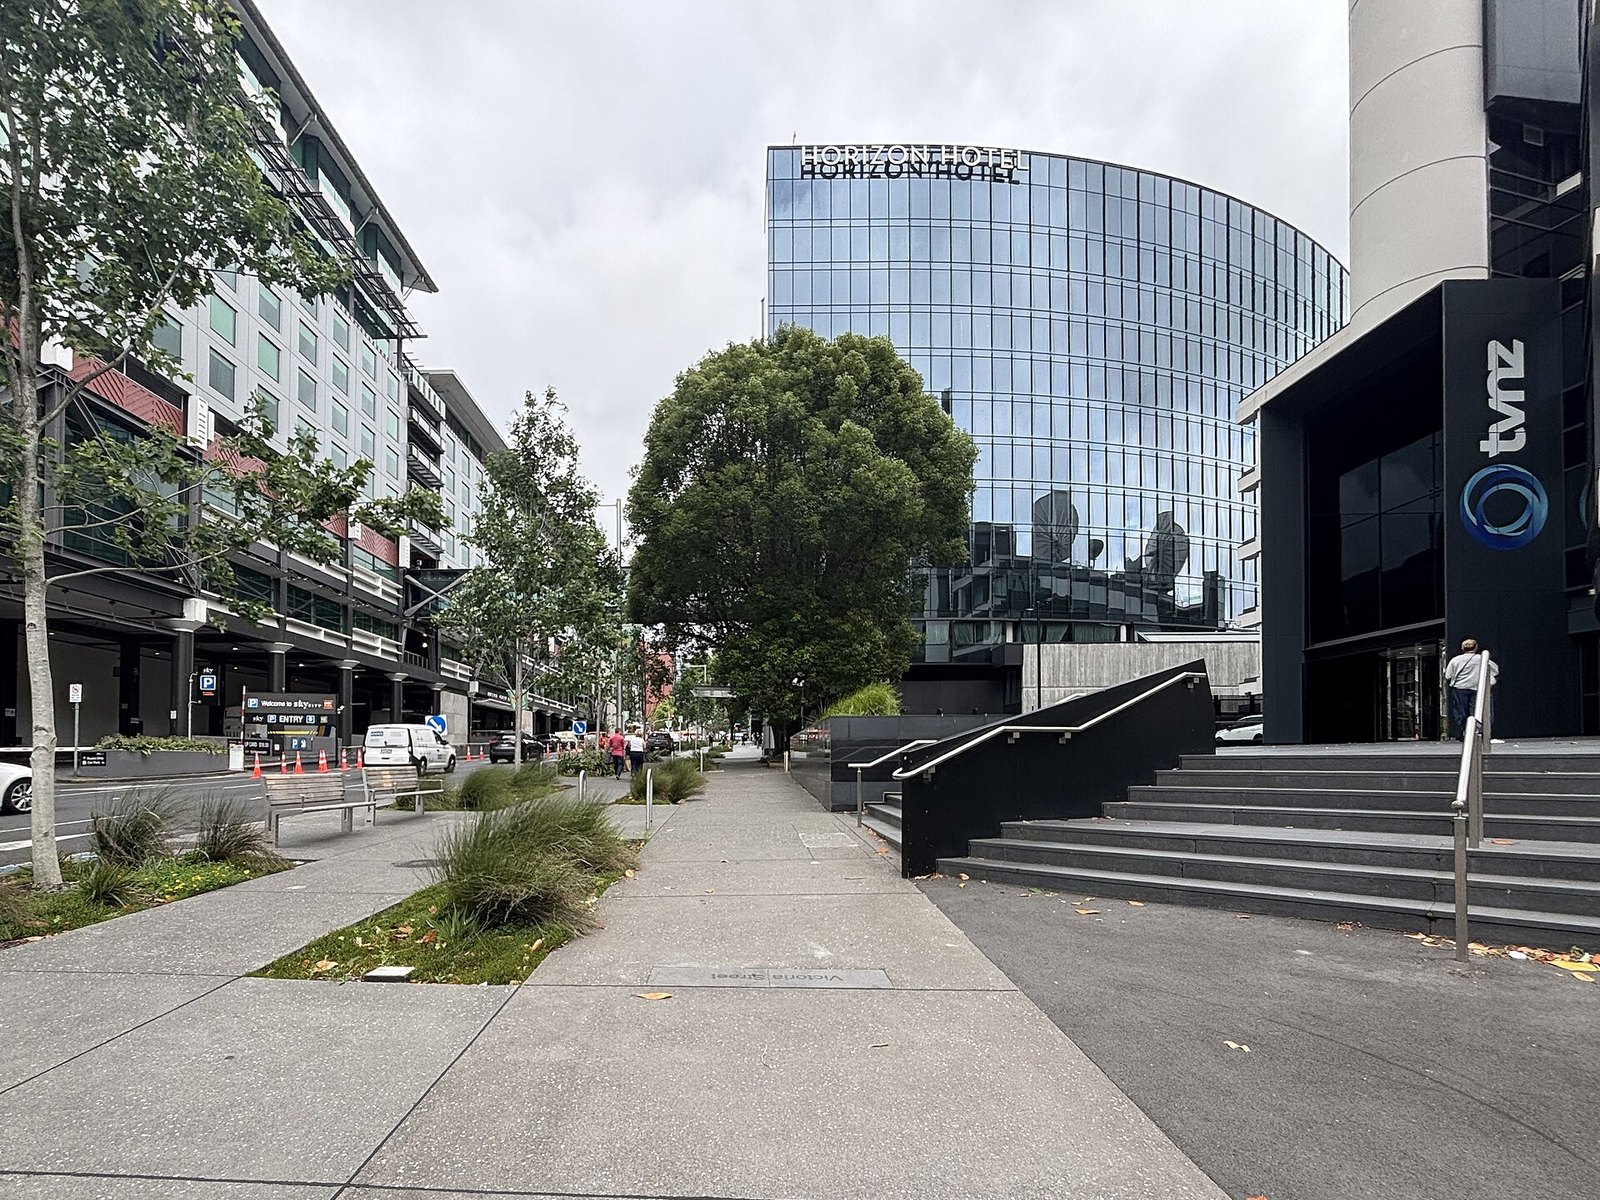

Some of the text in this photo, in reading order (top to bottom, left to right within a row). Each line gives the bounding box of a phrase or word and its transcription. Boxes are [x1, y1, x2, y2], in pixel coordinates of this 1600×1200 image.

[800, 145, 1030, 171] HORIZON HOTEL
[1480, 339, 1527, 458] tvnz
[260, 700, 286, 708] Welcome
[286, 700, 293, 708] to
[279, 715, 304, 724] ENTRY
[711, 973, 844, 982] Victoria Street
